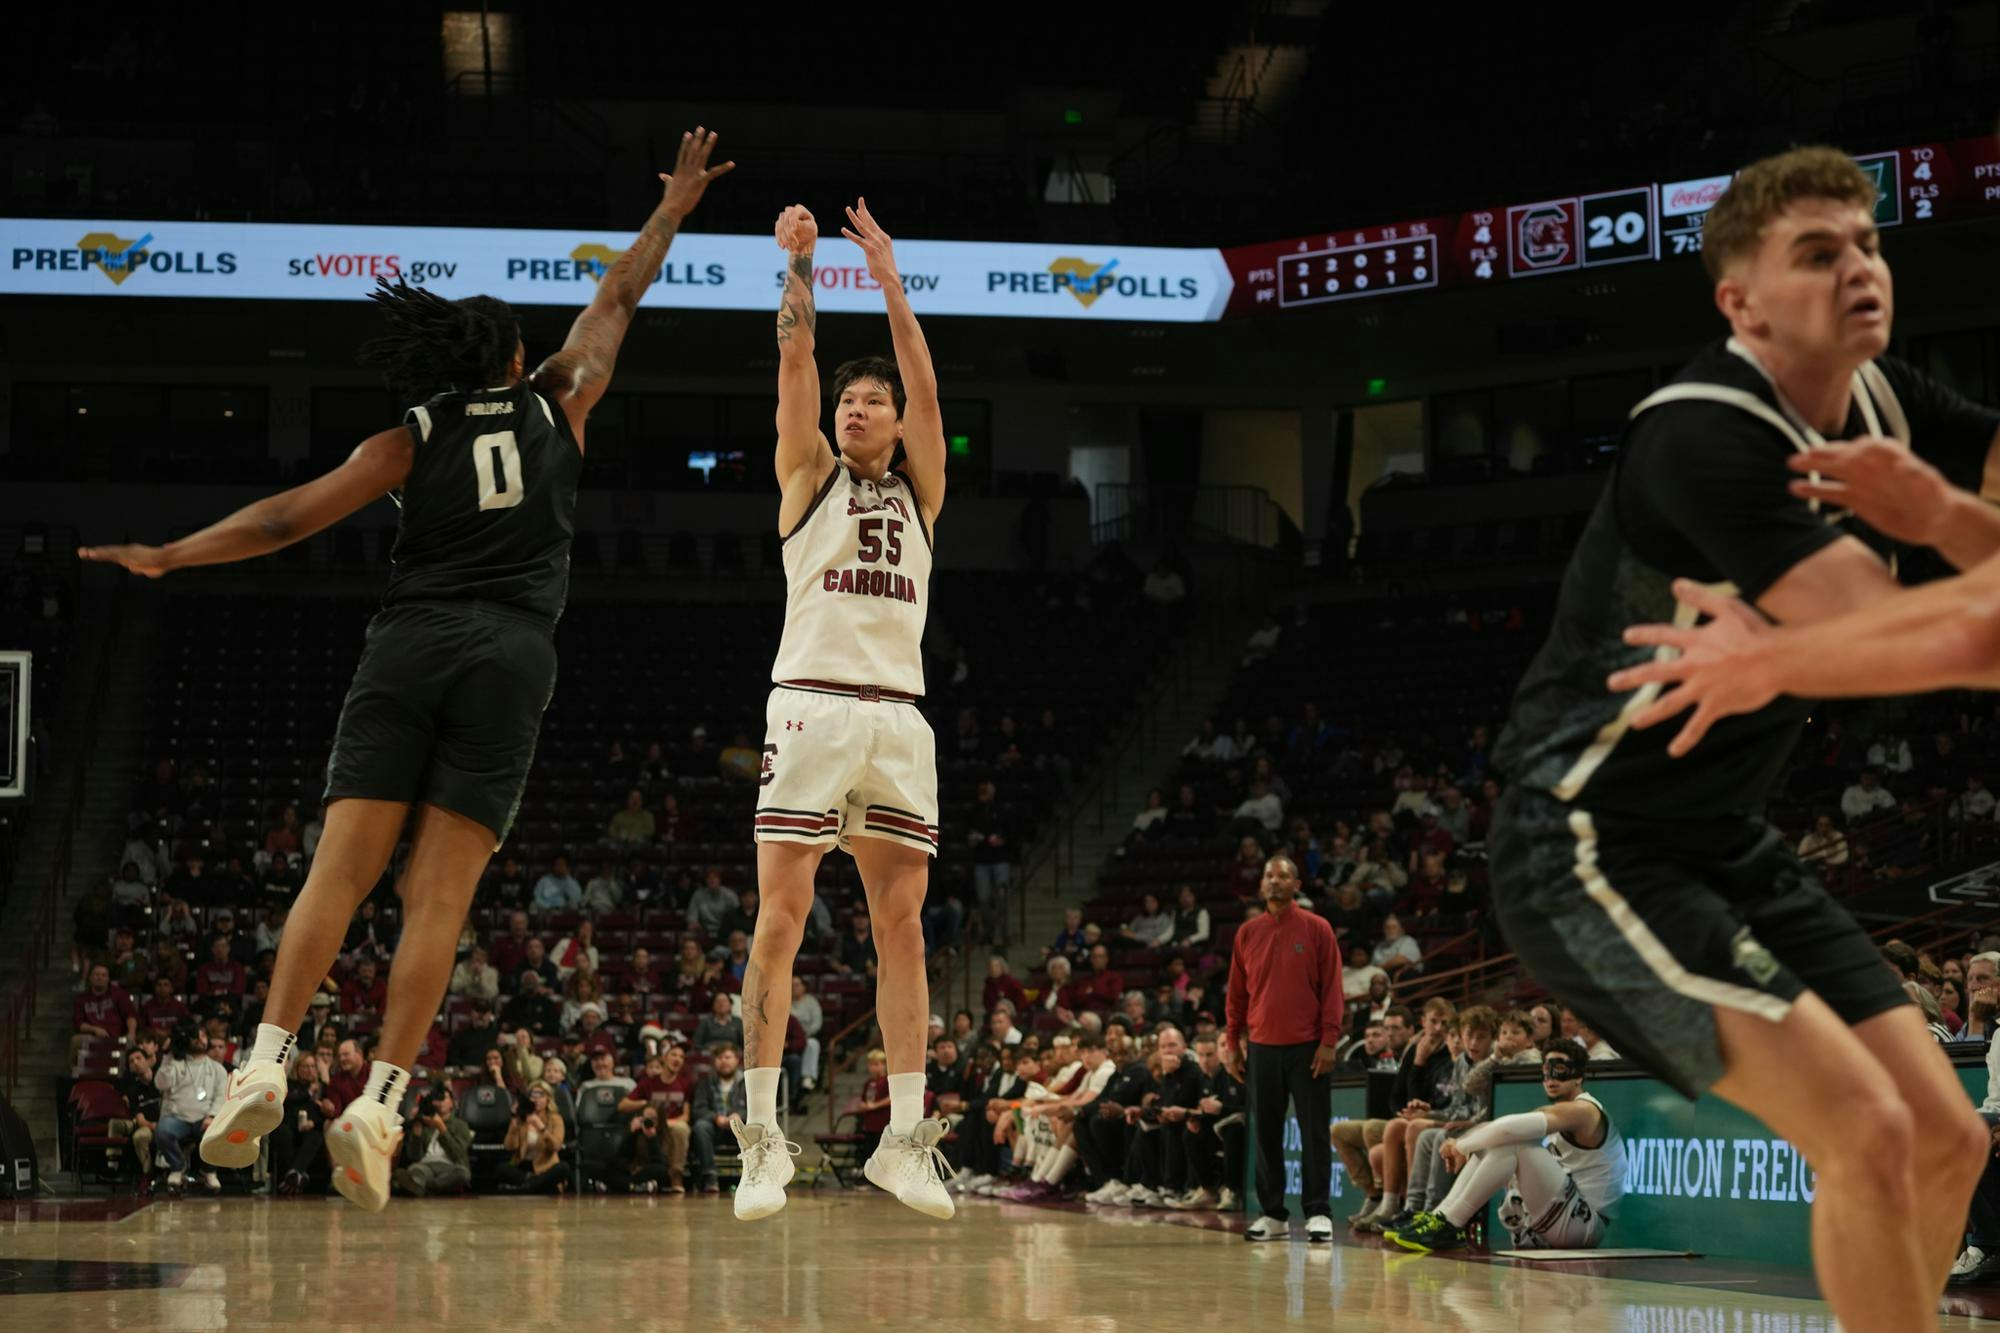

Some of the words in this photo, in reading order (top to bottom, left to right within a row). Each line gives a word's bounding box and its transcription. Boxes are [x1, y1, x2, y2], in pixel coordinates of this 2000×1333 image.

[1911, 147, 1934, 161] TO
[1913, 162, 1932, 180] 4
[1909, 184, 1940, 199] FLS
[1472, 211, 1494, 226] TO
[1915, 199, 1933, 219] 2
[1354, 231, 1365, 245] 6
[1473, 226, 1492, 244] 4
[1588, 211, 1646, 249] 20
[12, 248, 102, 271] PREP
[127, 250, 237, 274] POLLS
[1248, 269, 1275, 284] PTS
[1297, 262, 1309, 277] 2
[1326, 258, 1338, 273] 2
[1353, 253, 1368, 268] 0
[1384, 249, 1396, 264] 3
[1413, 245, 1426, 260] 2
[1470, 246, 1498, 262] FLS
[288, 253, 457, 284] scVOTES.gov
[507, 259, 594, 282] PREP
[652, 262, 726, 285] LLS
[1474, 260, 1493, 279] 4
[987, 271, 1070, 294] PREP
[1097, 274, 1199, 299] POLLS
[1256, 288, 1275, 303] PF
[1299, 282, 1309, 297] 1
[1325, 278, 1340, 293] 0
[1354, 274, 1369, 289] 0
[1385, 270, 1396, 285] 1
[1413, 266, 1427, 281] 0
[472, 430, 525, 512] 0
[858, 518, 904, 566] 55
[823, 568, 917, 605] CAROLINA
[1624, 1137, 1725, 1198] MINION
